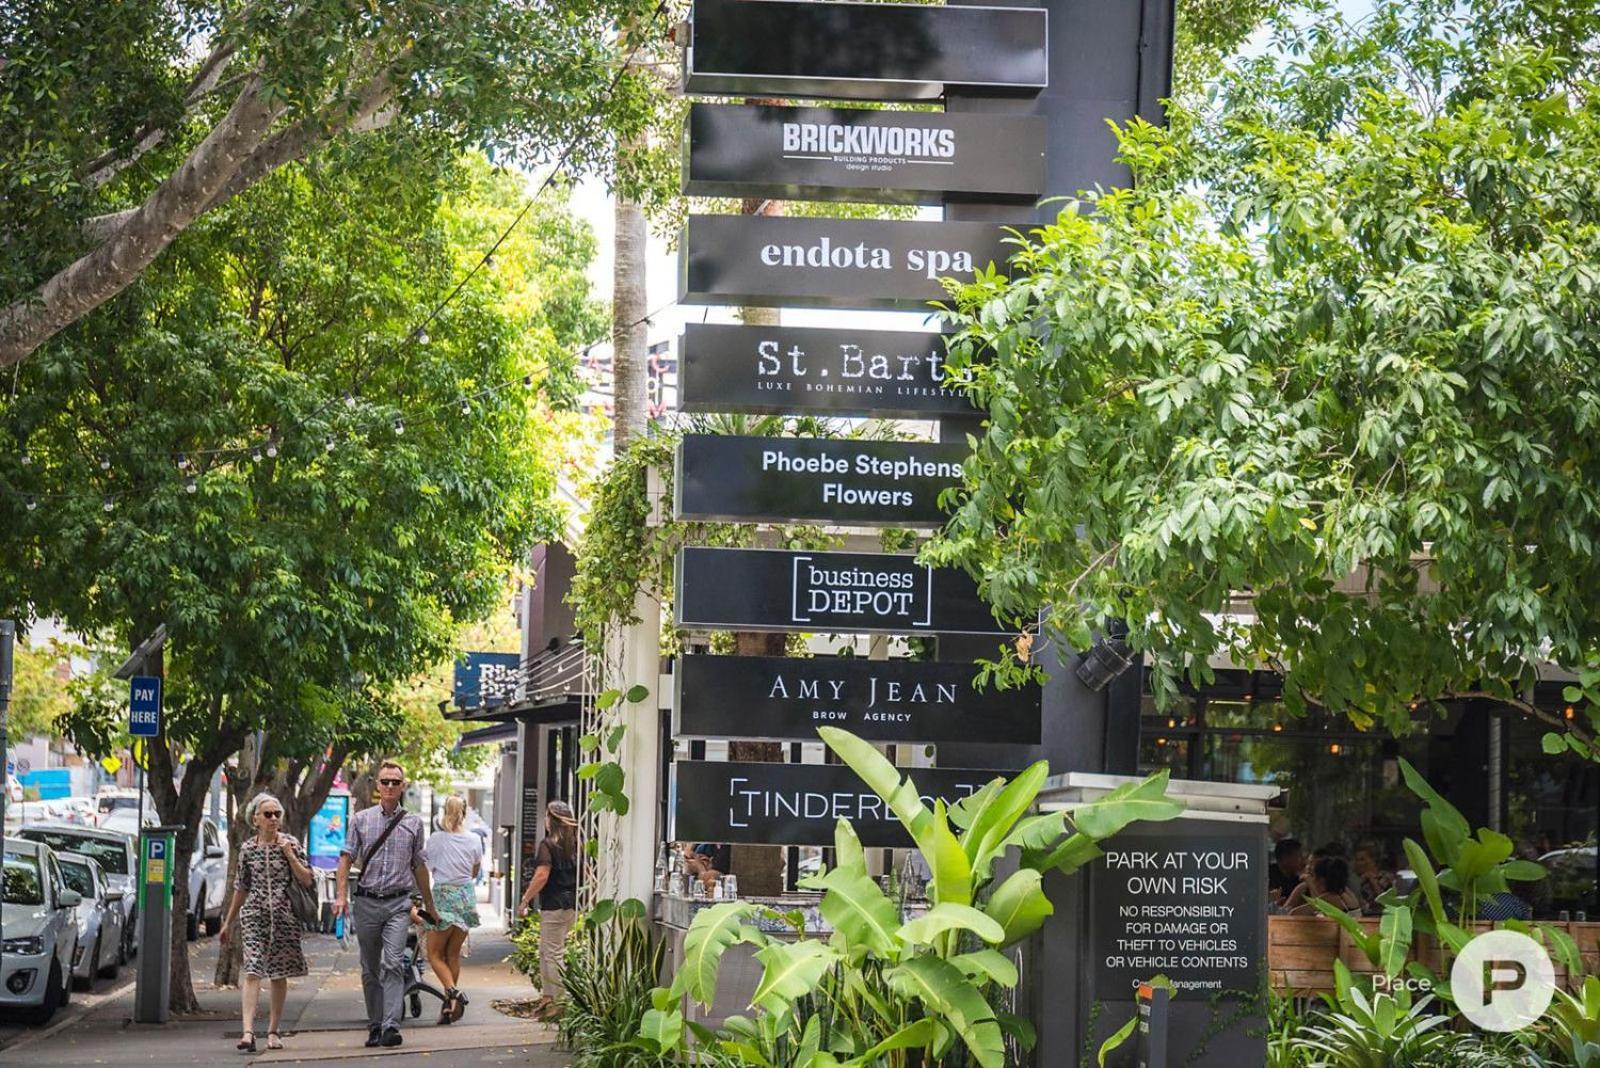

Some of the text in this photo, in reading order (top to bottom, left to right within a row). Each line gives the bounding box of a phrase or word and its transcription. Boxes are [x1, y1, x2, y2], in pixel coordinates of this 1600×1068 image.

[783, 123, 955, 157] BRICKWORKS
[833, 155, 906, 165] BUILDING PRODUCTS
[846, 163, 870, 172] design
[761, 237, 973, 279] endota spa
[758, 382, 791, 390] LUXE
[807, 384, 882, 393] BOHEMIAN
[762, 451, 962, 479] Phoebe Stephens
[824, 484, 912, 506] Flowers
[809, 566, 913, 588] business
[808, 589, 913, 615] DEPOT
[134, 689, 155, 701] PAY
[769, 676, 956, 707] AMY JEAN
[131, 711, 157, 724] HERE
[813, 711, 911, 721] BROW AGENCY
[1107, 852, 1248, 869] PARK AT YOUR
[1128, 877, 1227, 894] OWN RISK
[1120, 906, 1234, 917] NO RESPONSIBILTY
[1126, 923, 1228, 934] FOR DAMAGE OR
[1117, 940, 1236, 951] THEFT TO VEHICLES
[1106, 956, 1247, 968] OR VEHICLE CONTENTS
